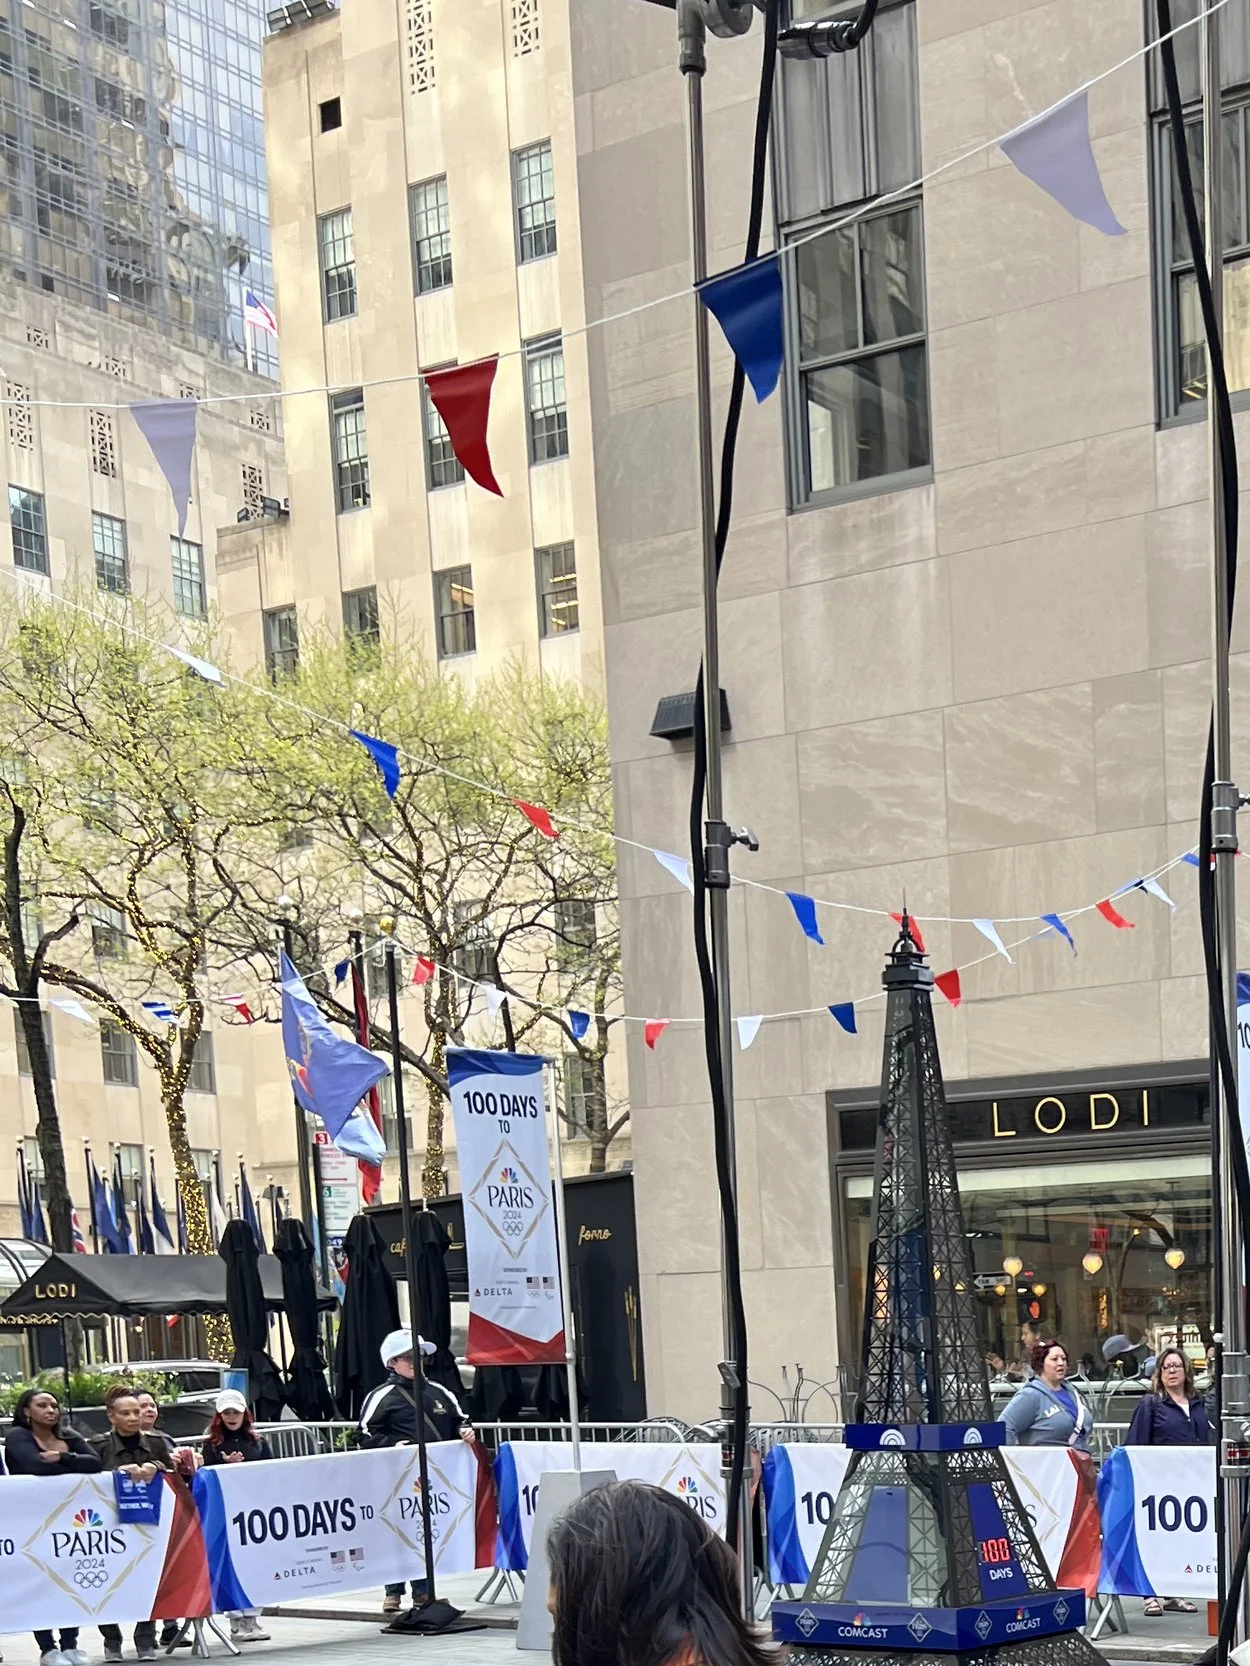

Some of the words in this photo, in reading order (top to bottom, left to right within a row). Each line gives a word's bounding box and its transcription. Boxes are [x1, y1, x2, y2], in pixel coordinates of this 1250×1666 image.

[463, 1090, 498, 1116] 100
[500, 1093, 538, 1119] DAYS
[992, 1089, 1149, 1137] LODI
[498, 1119, 511, 1134] TO
[487, 1185, 534, 1209] PARIS
[503, 1210, 522, 1220] 2024
[576, 1225, 612, 1246] forno
[34, 1283, 77, 1299] LODI
[483, 1287, 513, 1296] DELTA
[801, 1491, 834, 1525] 10
[1141, 1494, 1208, 1533] 100
[232, 1505, 289, 1546] 100
[292, 1497, 357, 1539] DAYS
[360, 1504, 374, 1520] TO
[51, 1528, 127, 1558] PARIS
[982, 1538, 1011, 1563] 100
[75, 1558, 105, 1570] 2024
[283, 1566, 316, 1578] DELTA
[989, 1567, 1014, 1581] DAYS
[837, 1626, 889, 1639] COMCAST
[1005, 1617, 1041, 1634] COMCAST
